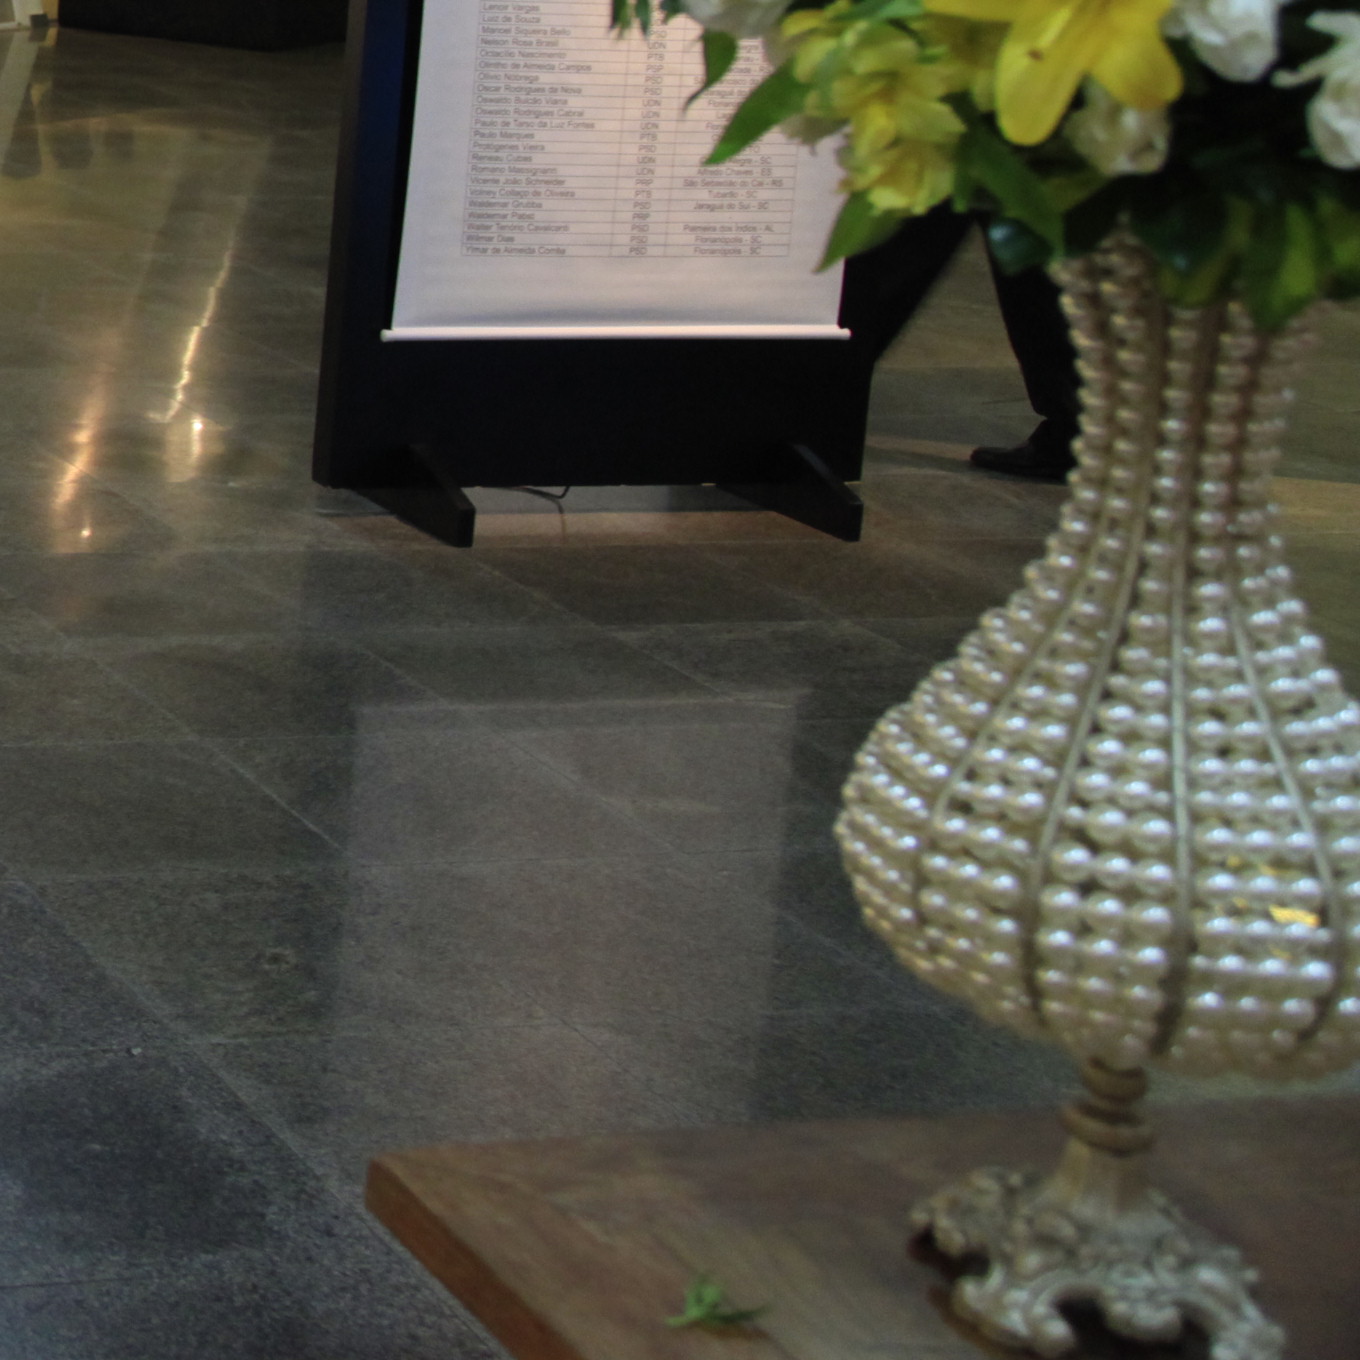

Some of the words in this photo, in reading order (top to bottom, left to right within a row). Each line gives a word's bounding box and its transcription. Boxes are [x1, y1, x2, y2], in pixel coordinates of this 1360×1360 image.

[482, 14, 500, 22] Luiz
[513, 15, 541, 23] Souza
[476, 84, 502, 92] Oscar
[503, 85, 546, 95] Rodrigues
[547, 85, 558, 93] da
[641, 87, 661, 95] PSD
[474, 119, 499, 127] Paulo
[499, 119, 511, 127] de
[536, 120, 548, 128] da
[549, 120, 565, 128] Luz
